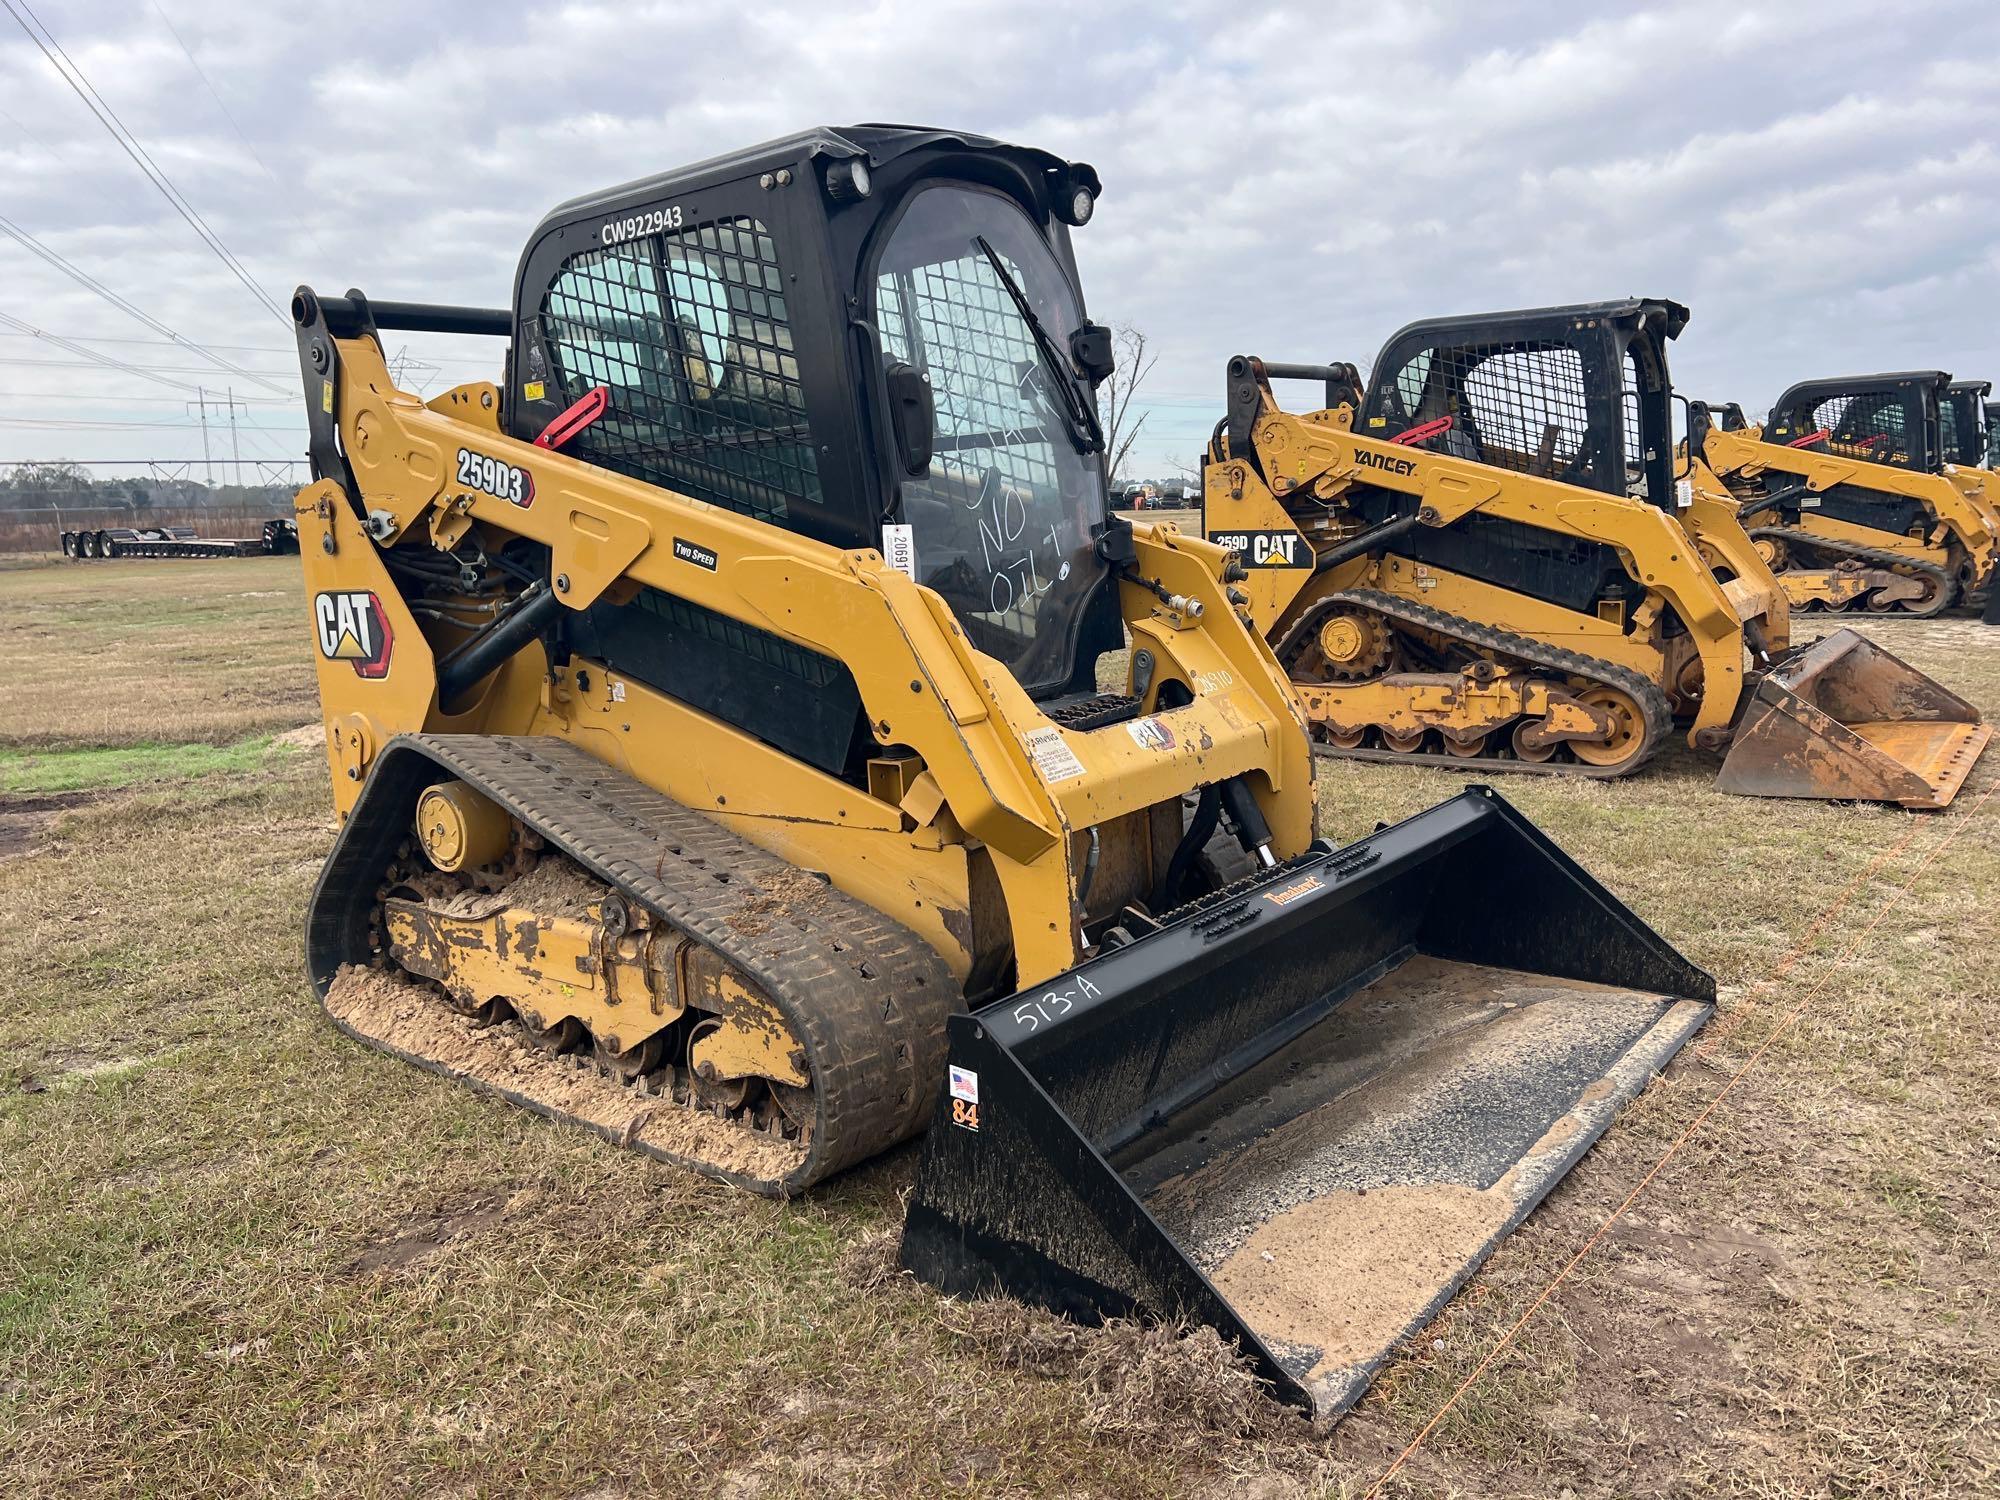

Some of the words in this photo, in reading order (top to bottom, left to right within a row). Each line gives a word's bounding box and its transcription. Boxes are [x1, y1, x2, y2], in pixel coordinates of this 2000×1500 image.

[602, 205, 682, 244] CW922943
[457, 448, 523, 504] 259D3
[1354, 448, 1417, 477] YANCEY
[979, 488, 1026, 573] NO
[1217, 535, 1248, 550] 259D
[1254, 535, 1297, 565] CAT
[676, 543, 692, 558] TWO
[692, 549, 715, 566] SPEED
[316, 593, 372, 657] CAT
[1013, 974, 1102, 1031] 513-A
[953, 1098, 979, 1129] 84
